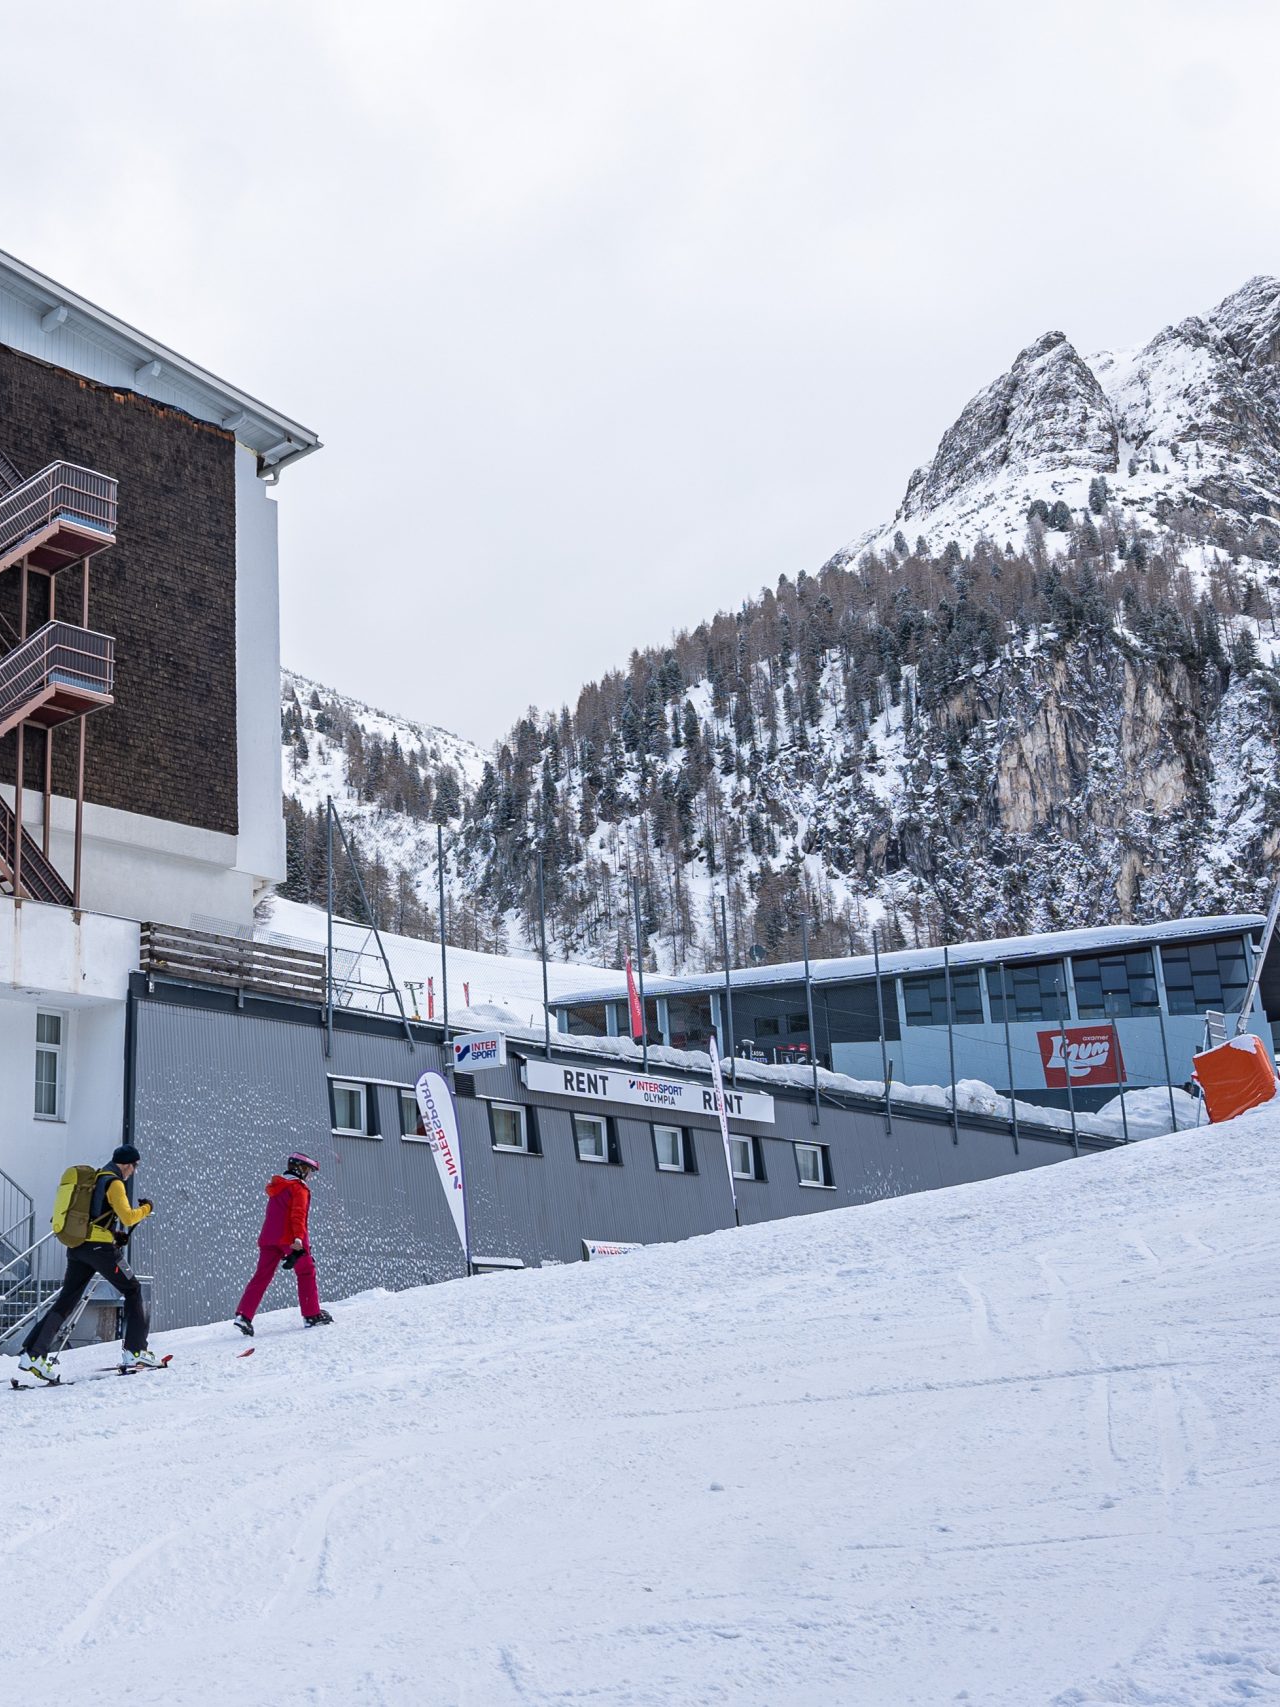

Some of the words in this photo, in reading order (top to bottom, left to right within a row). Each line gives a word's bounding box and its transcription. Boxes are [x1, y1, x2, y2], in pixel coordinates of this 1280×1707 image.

[471, 1040, 496, 1051] INTER
[471, 1049, 496, 1060] SPORT
[563, 1070, 609, 1095] RENT
[636, 1081, 683, 1096] INTERSPORT
[644, 1092, 676, 1106] OLYMPIA
